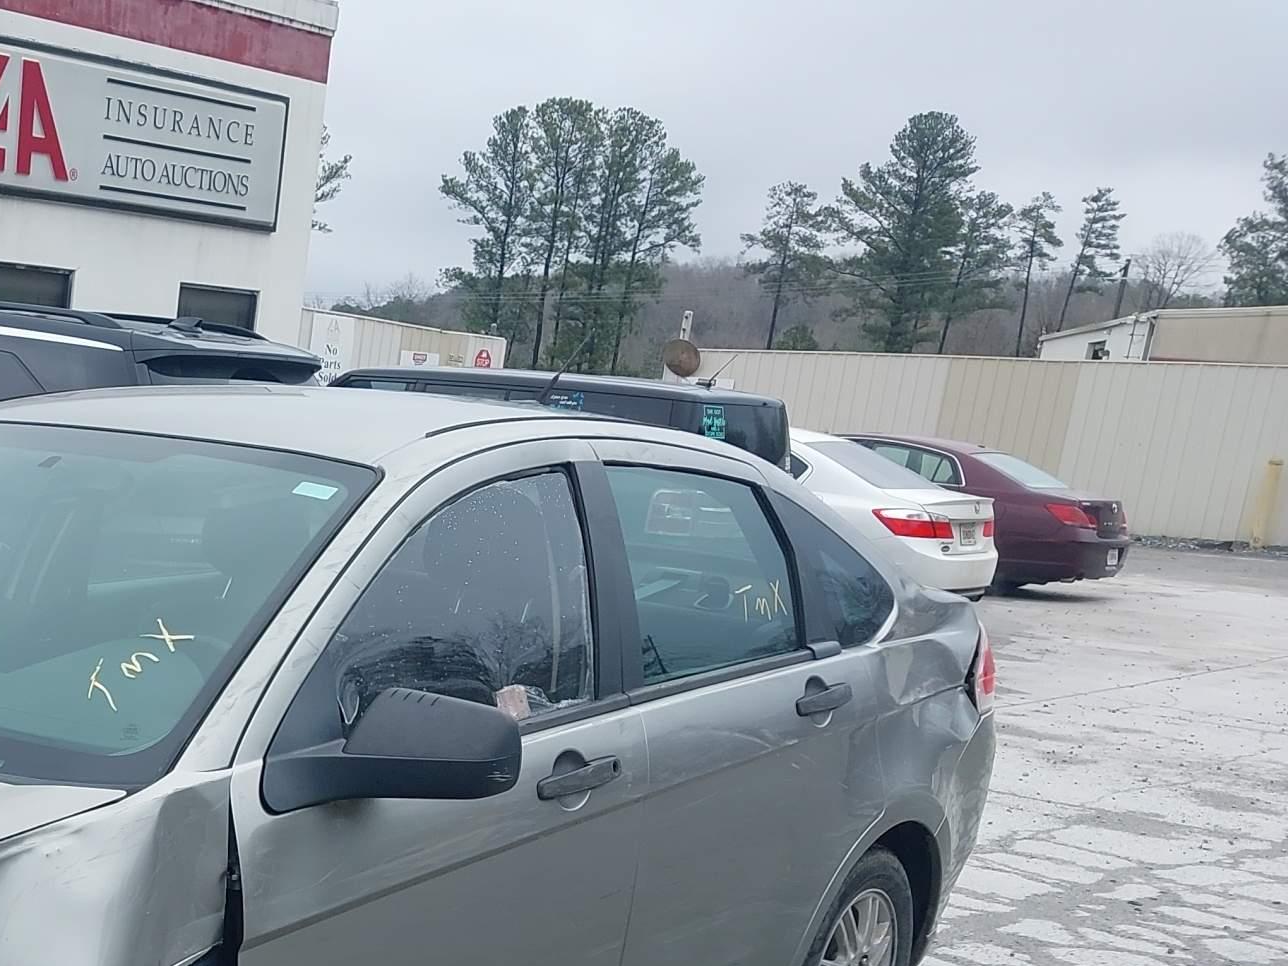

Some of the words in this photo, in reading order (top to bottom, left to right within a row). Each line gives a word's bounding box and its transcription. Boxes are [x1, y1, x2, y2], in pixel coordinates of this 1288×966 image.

[104, 97, 255, 146] INSURANCE
[101, 153, 156, 182] AUTO
[158, 162, 249, 197] AUCTIONS
[325, 344, 338, 356] No
